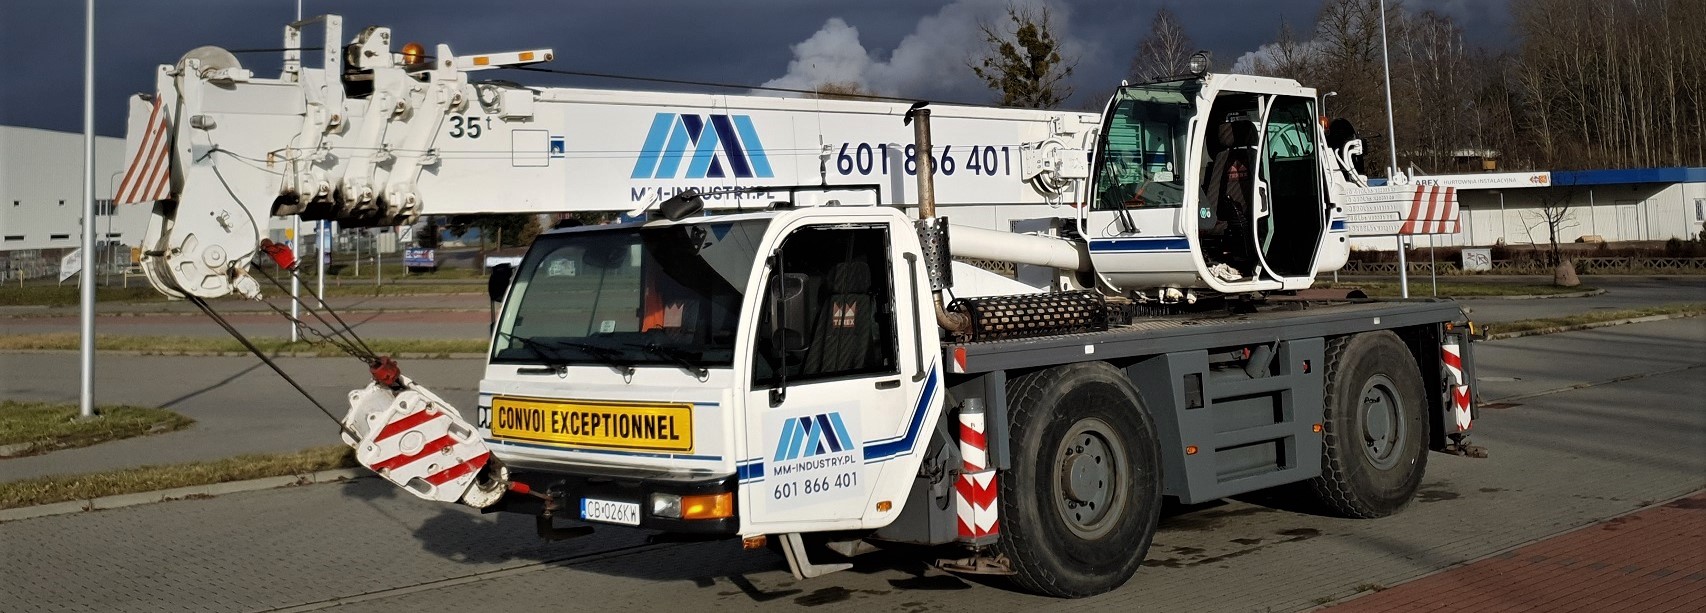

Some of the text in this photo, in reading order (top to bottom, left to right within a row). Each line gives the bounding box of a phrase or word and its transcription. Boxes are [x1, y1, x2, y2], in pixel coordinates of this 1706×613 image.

[449, 115, 492, 139] 35 t
[836, 142, 890, 176] 601
[965, 145, 1011, 176] 401
[631, 185, 775, 202] M-IUSTRY.PL
[499, 405, 546, 433] CONVOI
[551, 410, 680, 441] EXCEPTIONNEL
[773, 454, 856, 477] MM-INDUSTRY.PL
[774, 471, 858, 500] 601 866 401
